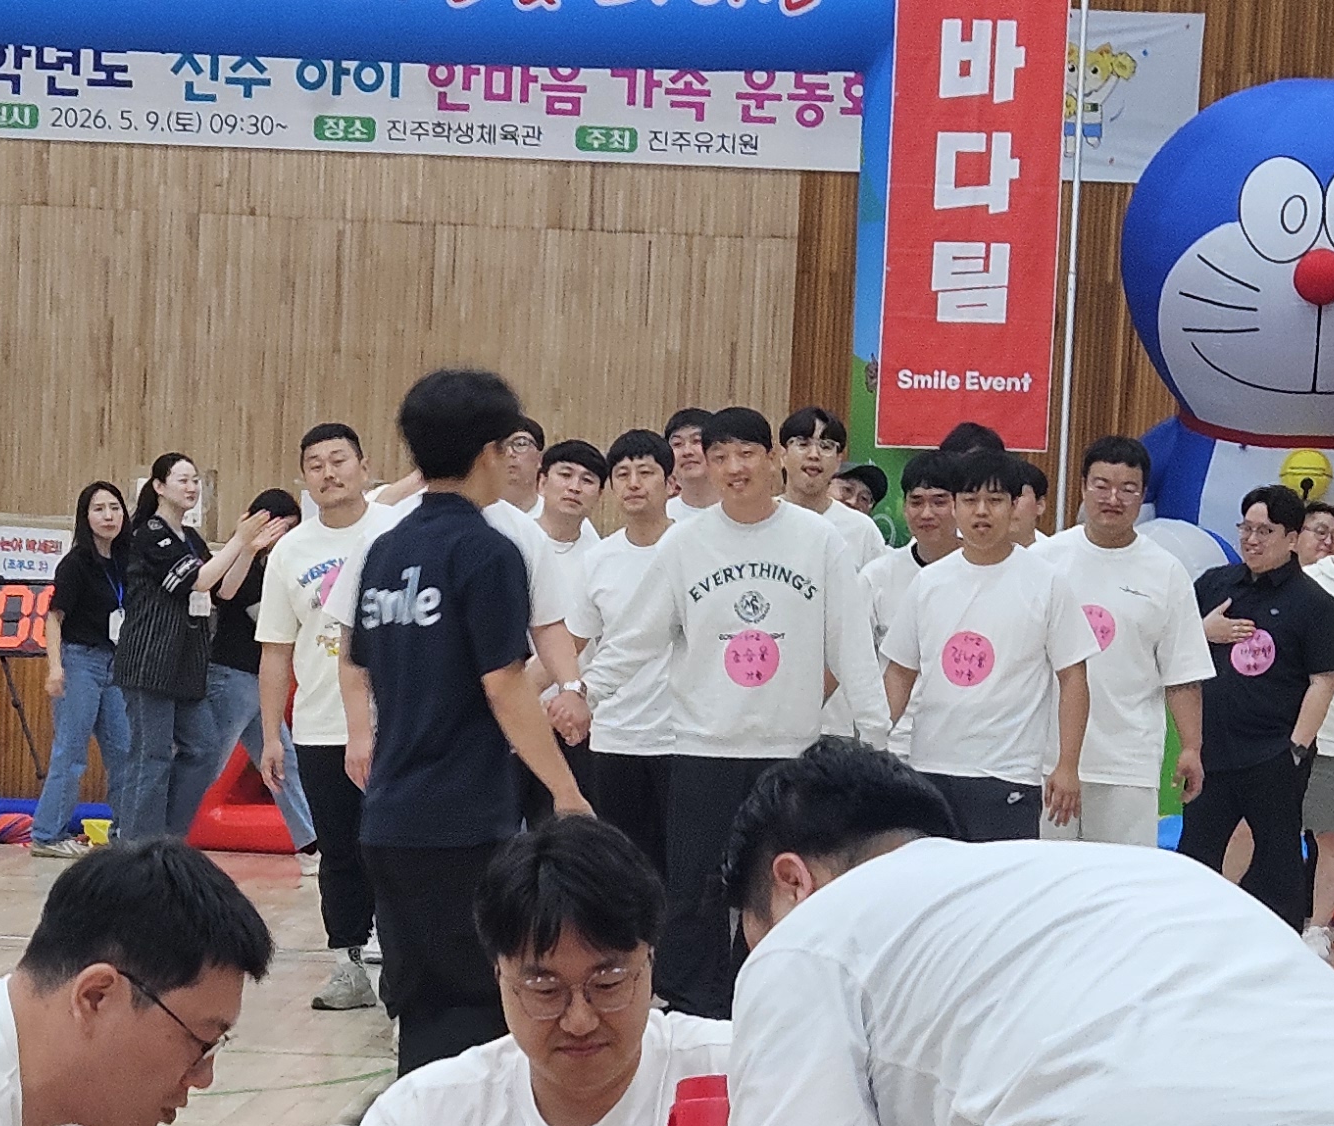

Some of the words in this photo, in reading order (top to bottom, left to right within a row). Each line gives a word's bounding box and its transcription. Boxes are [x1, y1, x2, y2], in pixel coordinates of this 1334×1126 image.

[171, 52, 271, 102] 진주
[296, 58, 401, 98] 아이
[427, 63, 587, 116] 한마음
[610, 68, 712, 122] 가족
[51, 106, 112, 130] 2026.
[120, 110, 138, 131] 5.
[209, 113, 288, 136] 09:30~
[322, 118, 369, 139] 장소
[386, 120, 543, 147] 진주학생체육관
[585, 128, 630, 150] 주최
[648, 130, 758, 155] 진주유치원
[932, 19, 1025, 323] 바다팀
[897, 368, 960, 391] Smile
[966, 371, 1032, 392] Event
[688, 562, 818, 602] EVERYTHING'S
